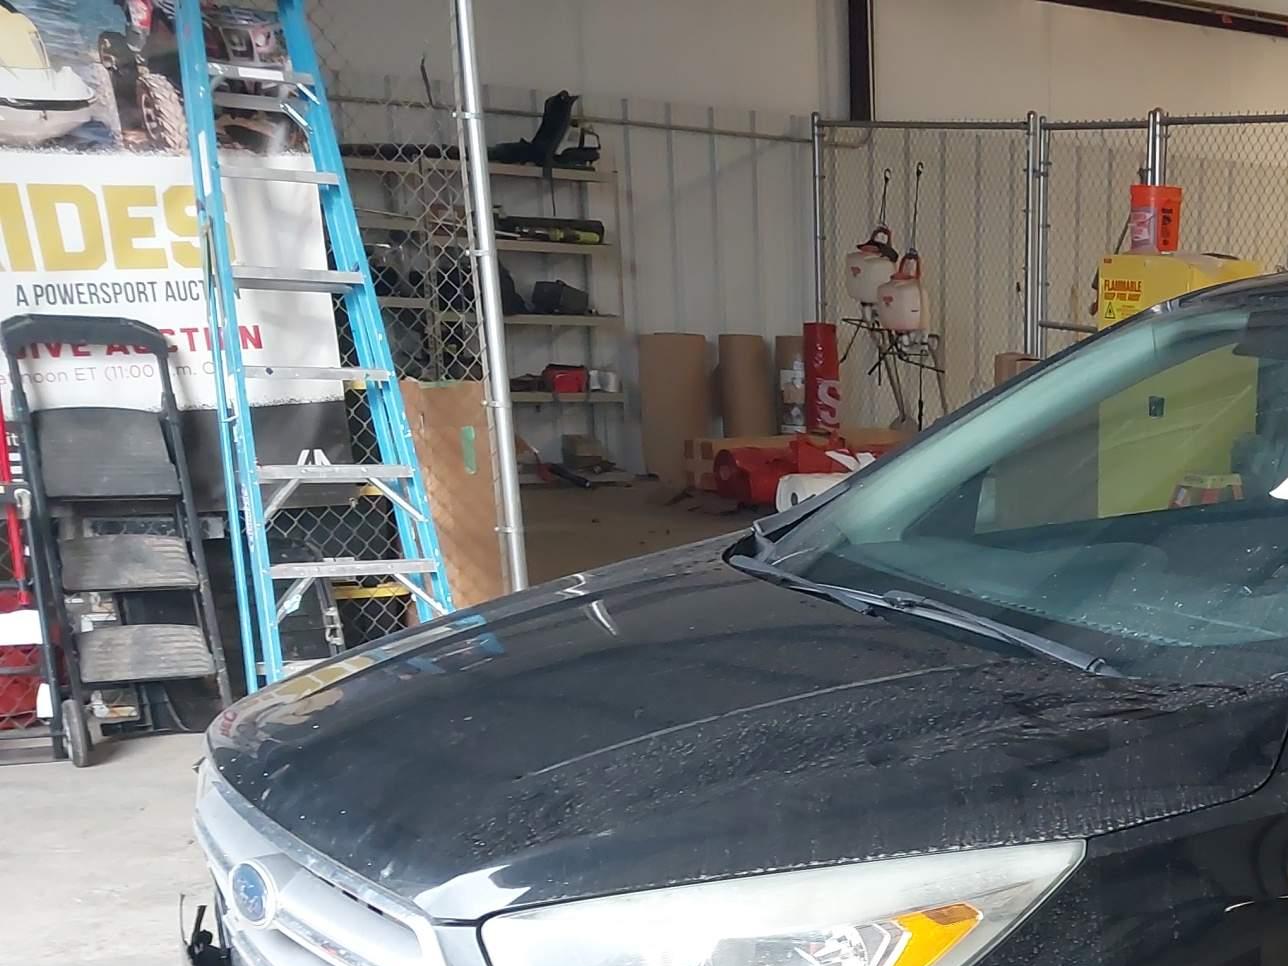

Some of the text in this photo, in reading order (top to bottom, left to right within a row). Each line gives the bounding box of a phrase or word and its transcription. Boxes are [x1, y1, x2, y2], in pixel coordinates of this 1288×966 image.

[16, 284, 29, 306] A
[32, 281, 158, 306] POWERSPORT
[75, 366, 97, 382] ET
[104, 362, 153, 382] (11:00
